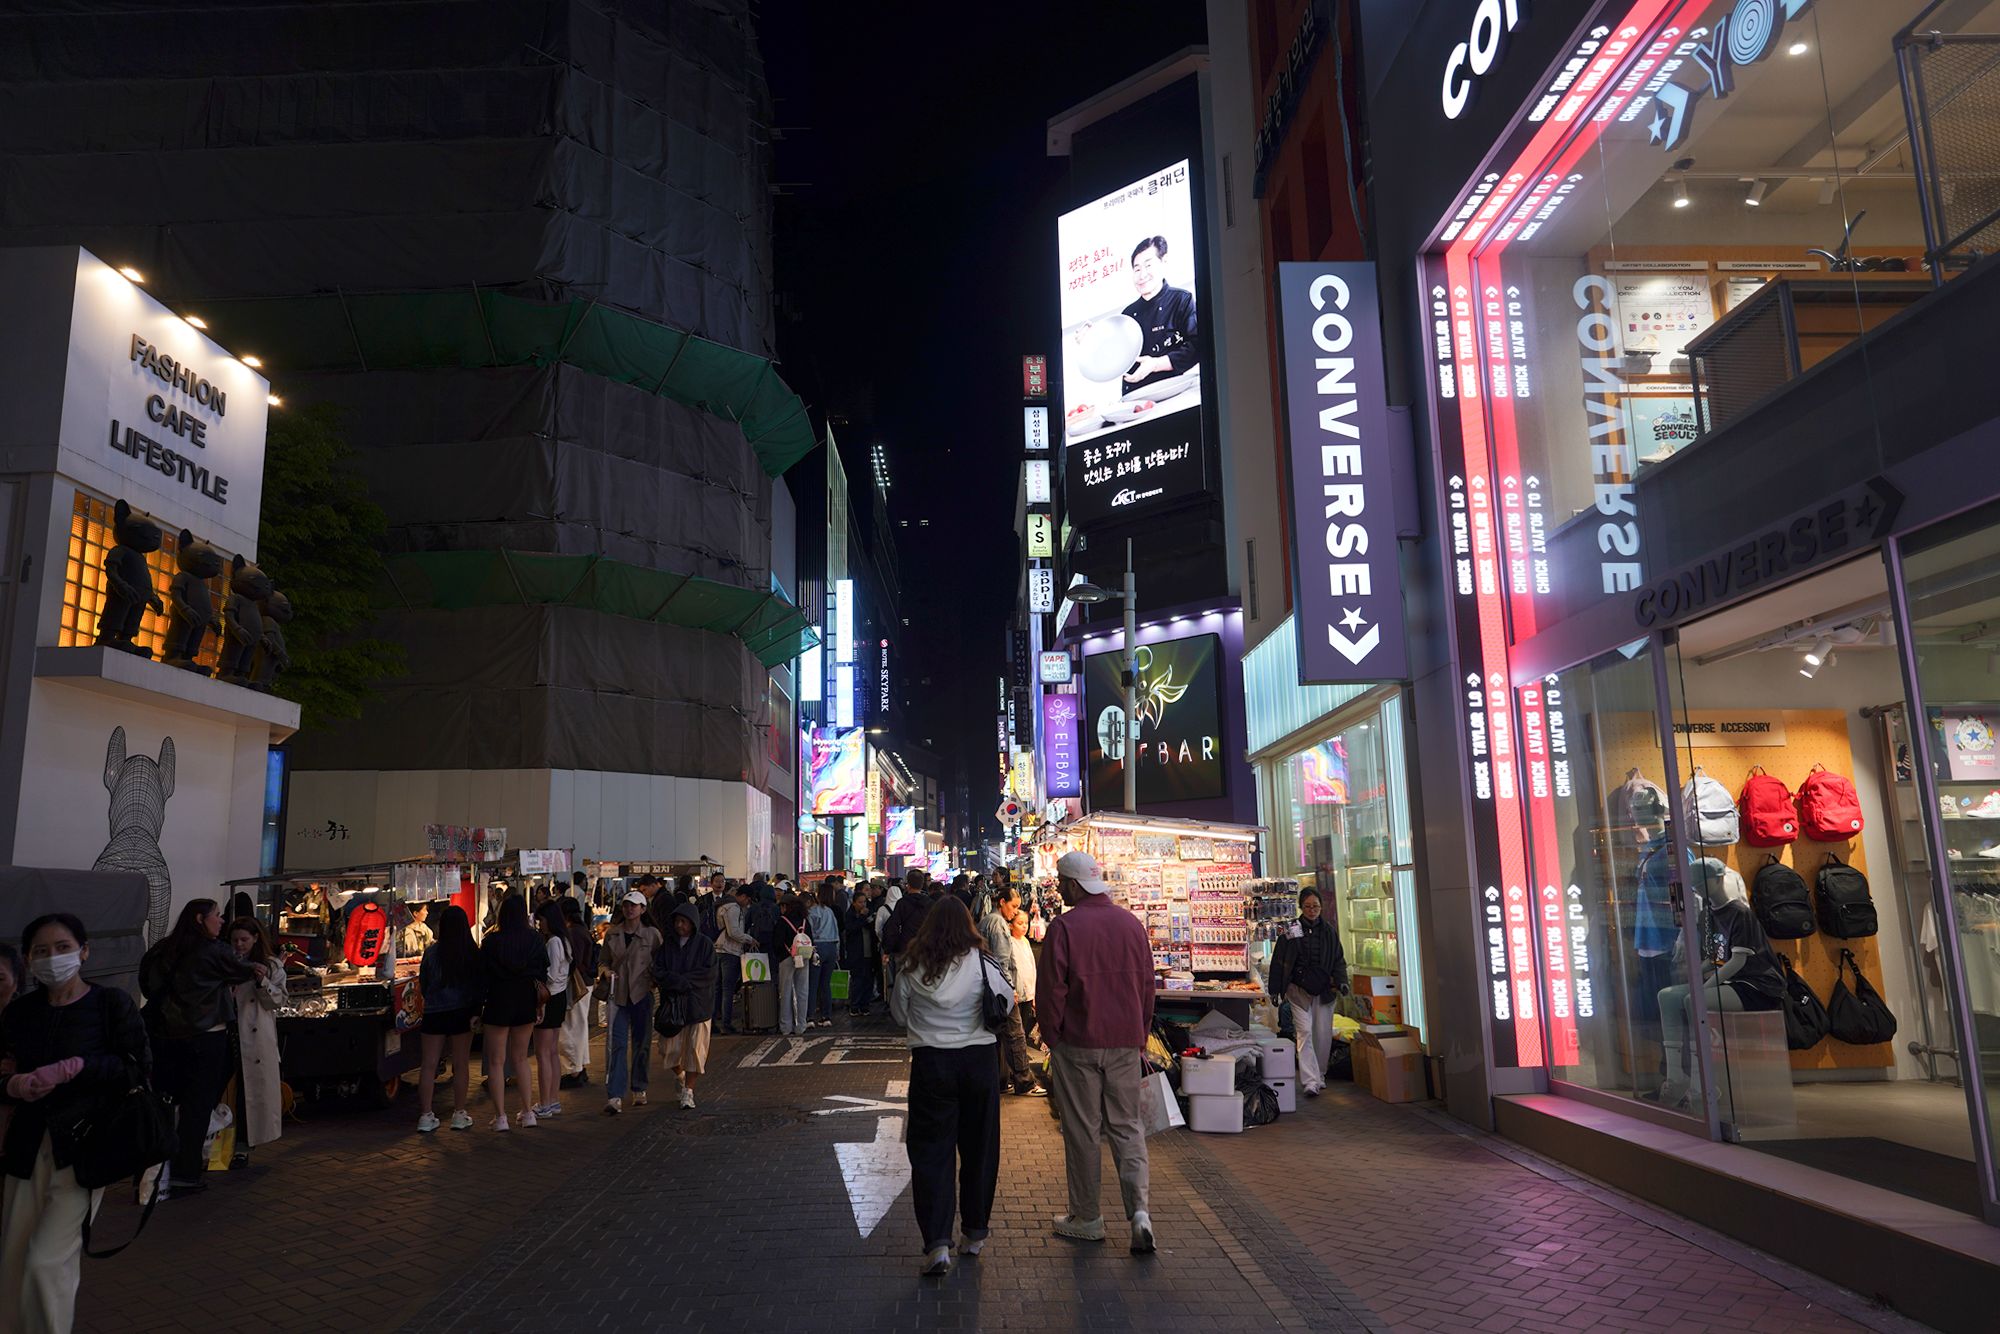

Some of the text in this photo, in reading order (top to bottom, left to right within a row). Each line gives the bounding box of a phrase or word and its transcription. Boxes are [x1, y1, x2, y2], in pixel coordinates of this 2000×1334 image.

[1442, 0, 1519, 120] CO
[1147, 167, 1185, 196] 클래딘
[130, 334, 227, 416] FASHION
[1029, 365, 1042, 395] 부동산
[147, 394, 207, 449] CAFE
[1032, 409, 1041, 447] 삼성빌딩
[1309, 274, 1372, 597] CONVERSE
[110, 419, 228, 505] LIFESTYLE
[1083, 440, 1131, 468] 좋은 도구가
[1084, 442, 1189, 487] 맛있는 요리를 만듭니다!
[1635, 500, 1849, 628] CONVERSE
[1040, 570, 1050, 607] apple
[880, 669, 889, 712] SKYPARK
[1720, 722, 1771, 733] ACCESSORY
[1054, 732, 1071, 790] ELFBAR
